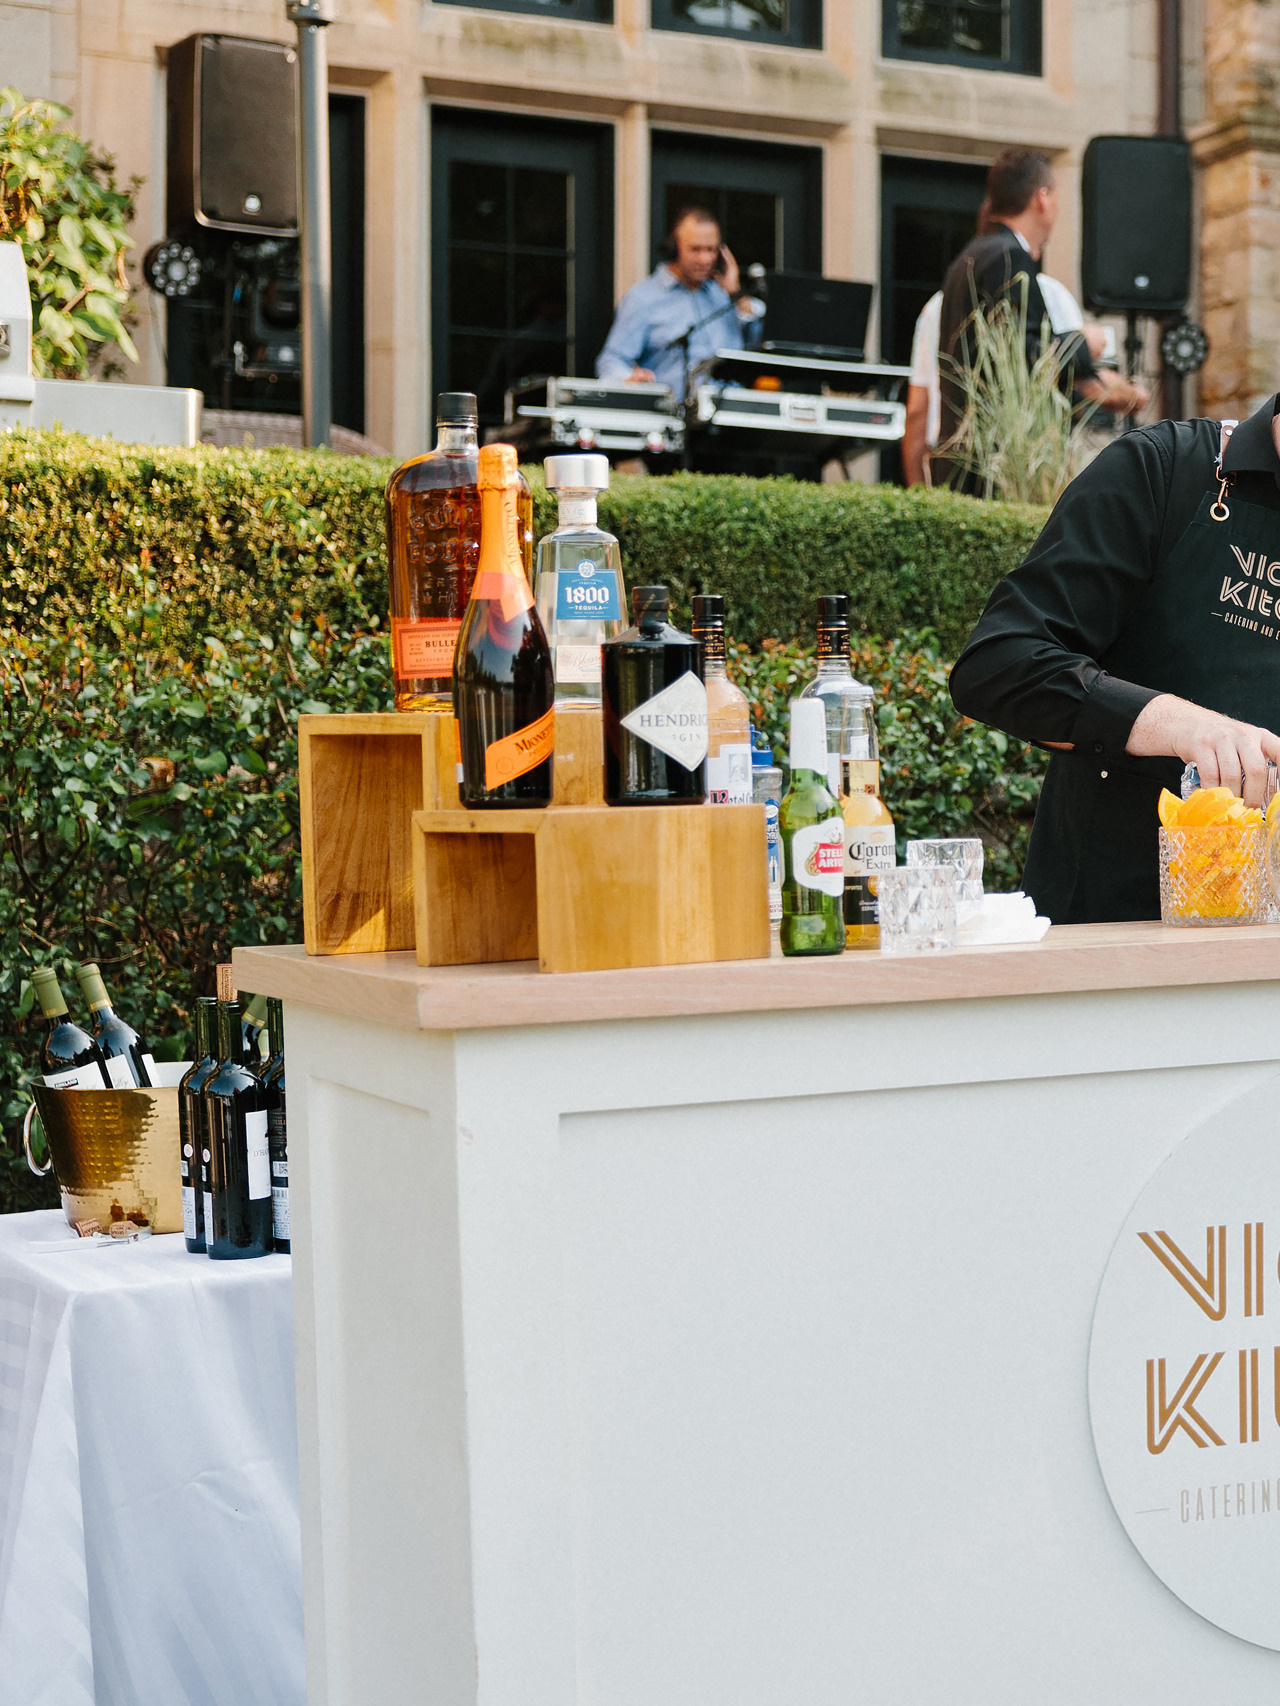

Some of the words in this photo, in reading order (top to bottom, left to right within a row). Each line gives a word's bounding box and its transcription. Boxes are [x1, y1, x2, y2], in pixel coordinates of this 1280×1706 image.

[564, 586, 610, 604] 1800
[1224, 612, 1259, 632] CATERING
[1260, 624, 1274, 638] AND
[425, 639, 457, 648] BULLE
[640, 714, 708, 728] HENDRIC
[679, 733, 702, 742] GIN
[819, 848, 843, 858] STELL
[849, 842, 896, 863] Coron
[818, 858, 843, 868] ARTO
[866, 858, 892, 870] Extra
